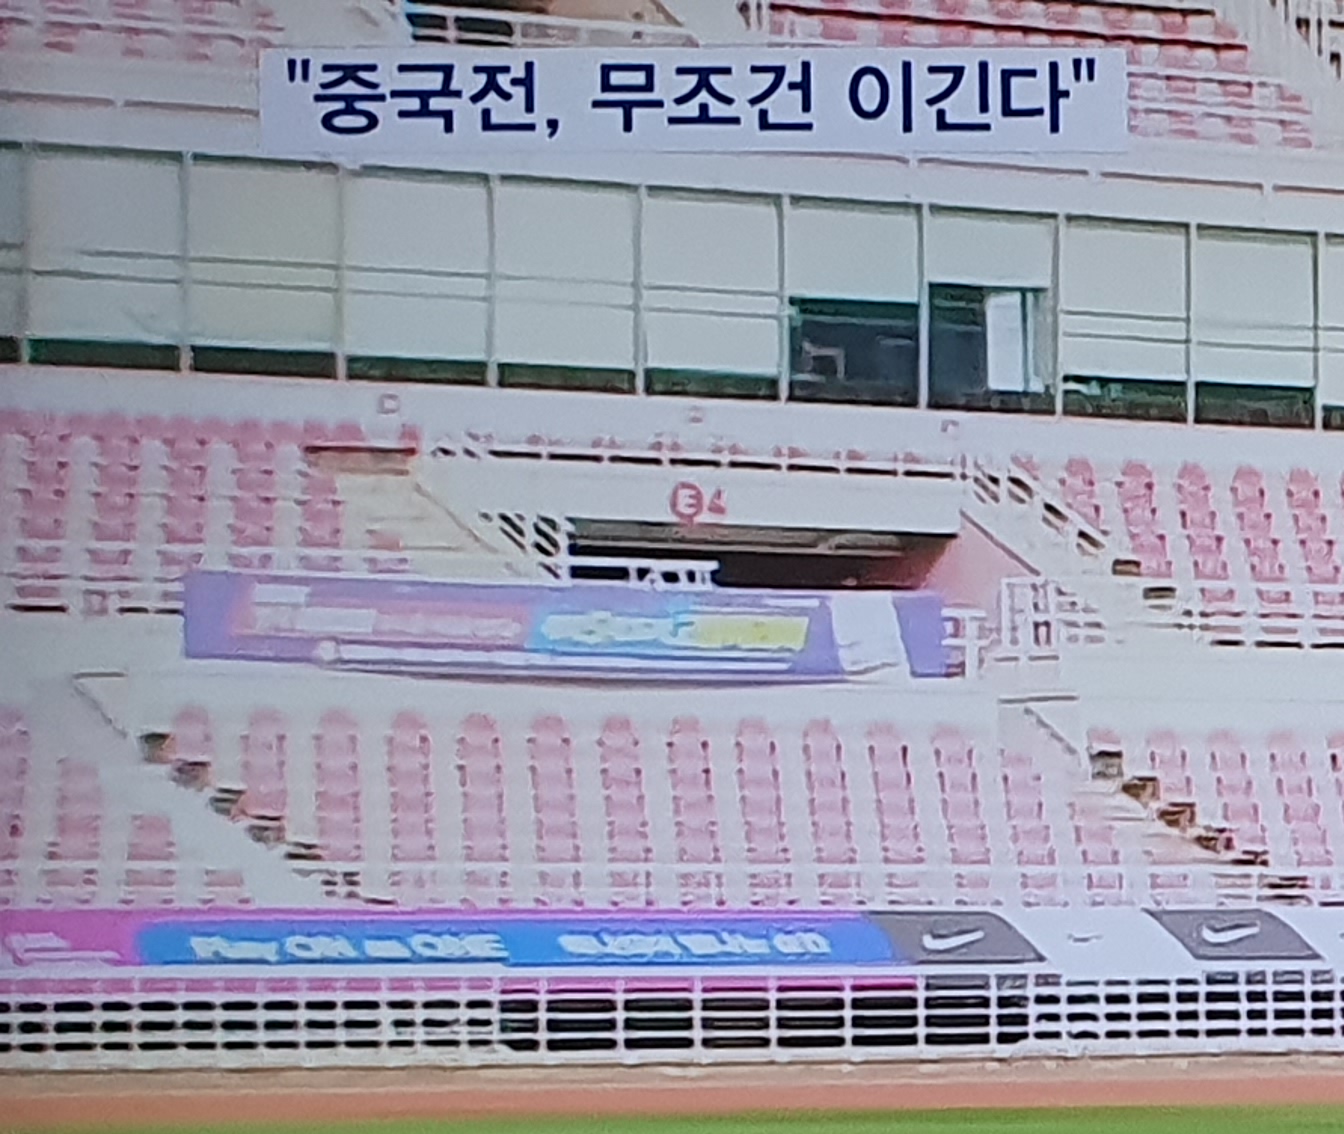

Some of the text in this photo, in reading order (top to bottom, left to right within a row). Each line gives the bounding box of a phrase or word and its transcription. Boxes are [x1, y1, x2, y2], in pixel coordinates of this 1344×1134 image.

[287, 57, 1094, 139] "중국전, 무조건 이긴다"
